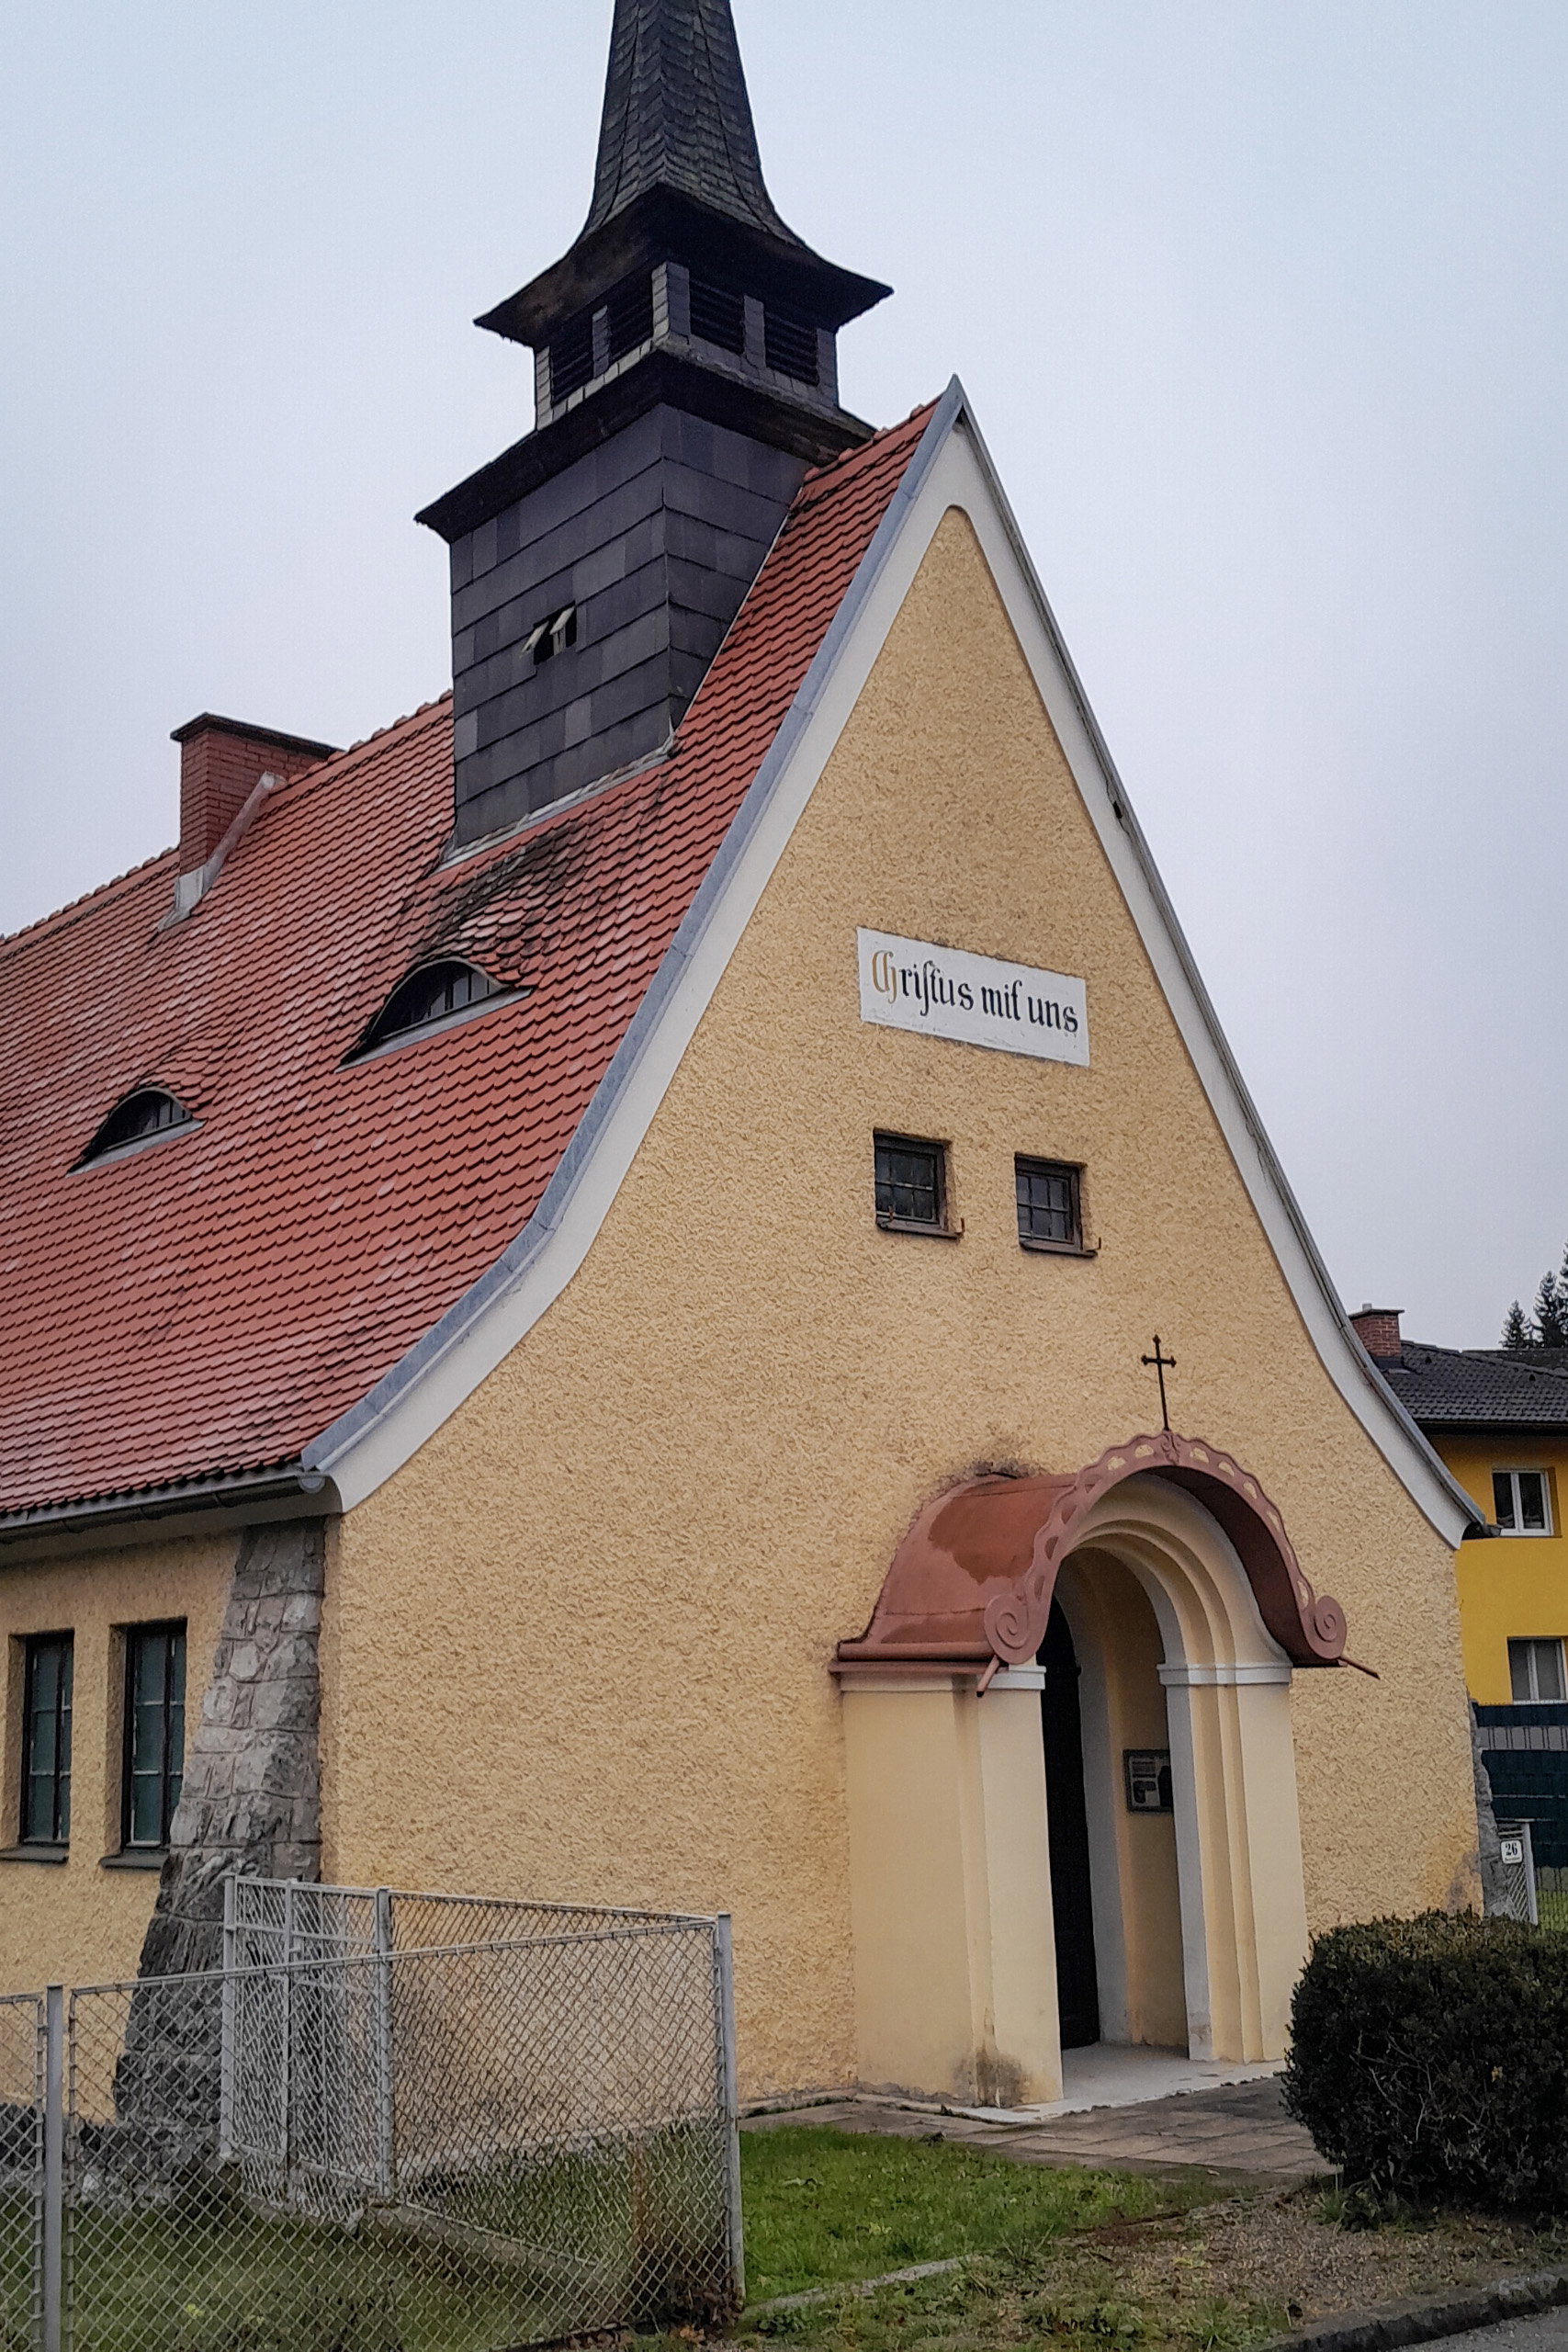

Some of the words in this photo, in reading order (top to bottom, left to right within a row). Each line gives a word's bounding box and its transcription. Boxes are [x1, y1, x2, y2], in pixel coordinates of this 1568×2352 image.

[980, 979, 1022, 1021] mit
[1027, 995, 1078, 1033] uns
[1505, 1841, 1518, 1856] 26
